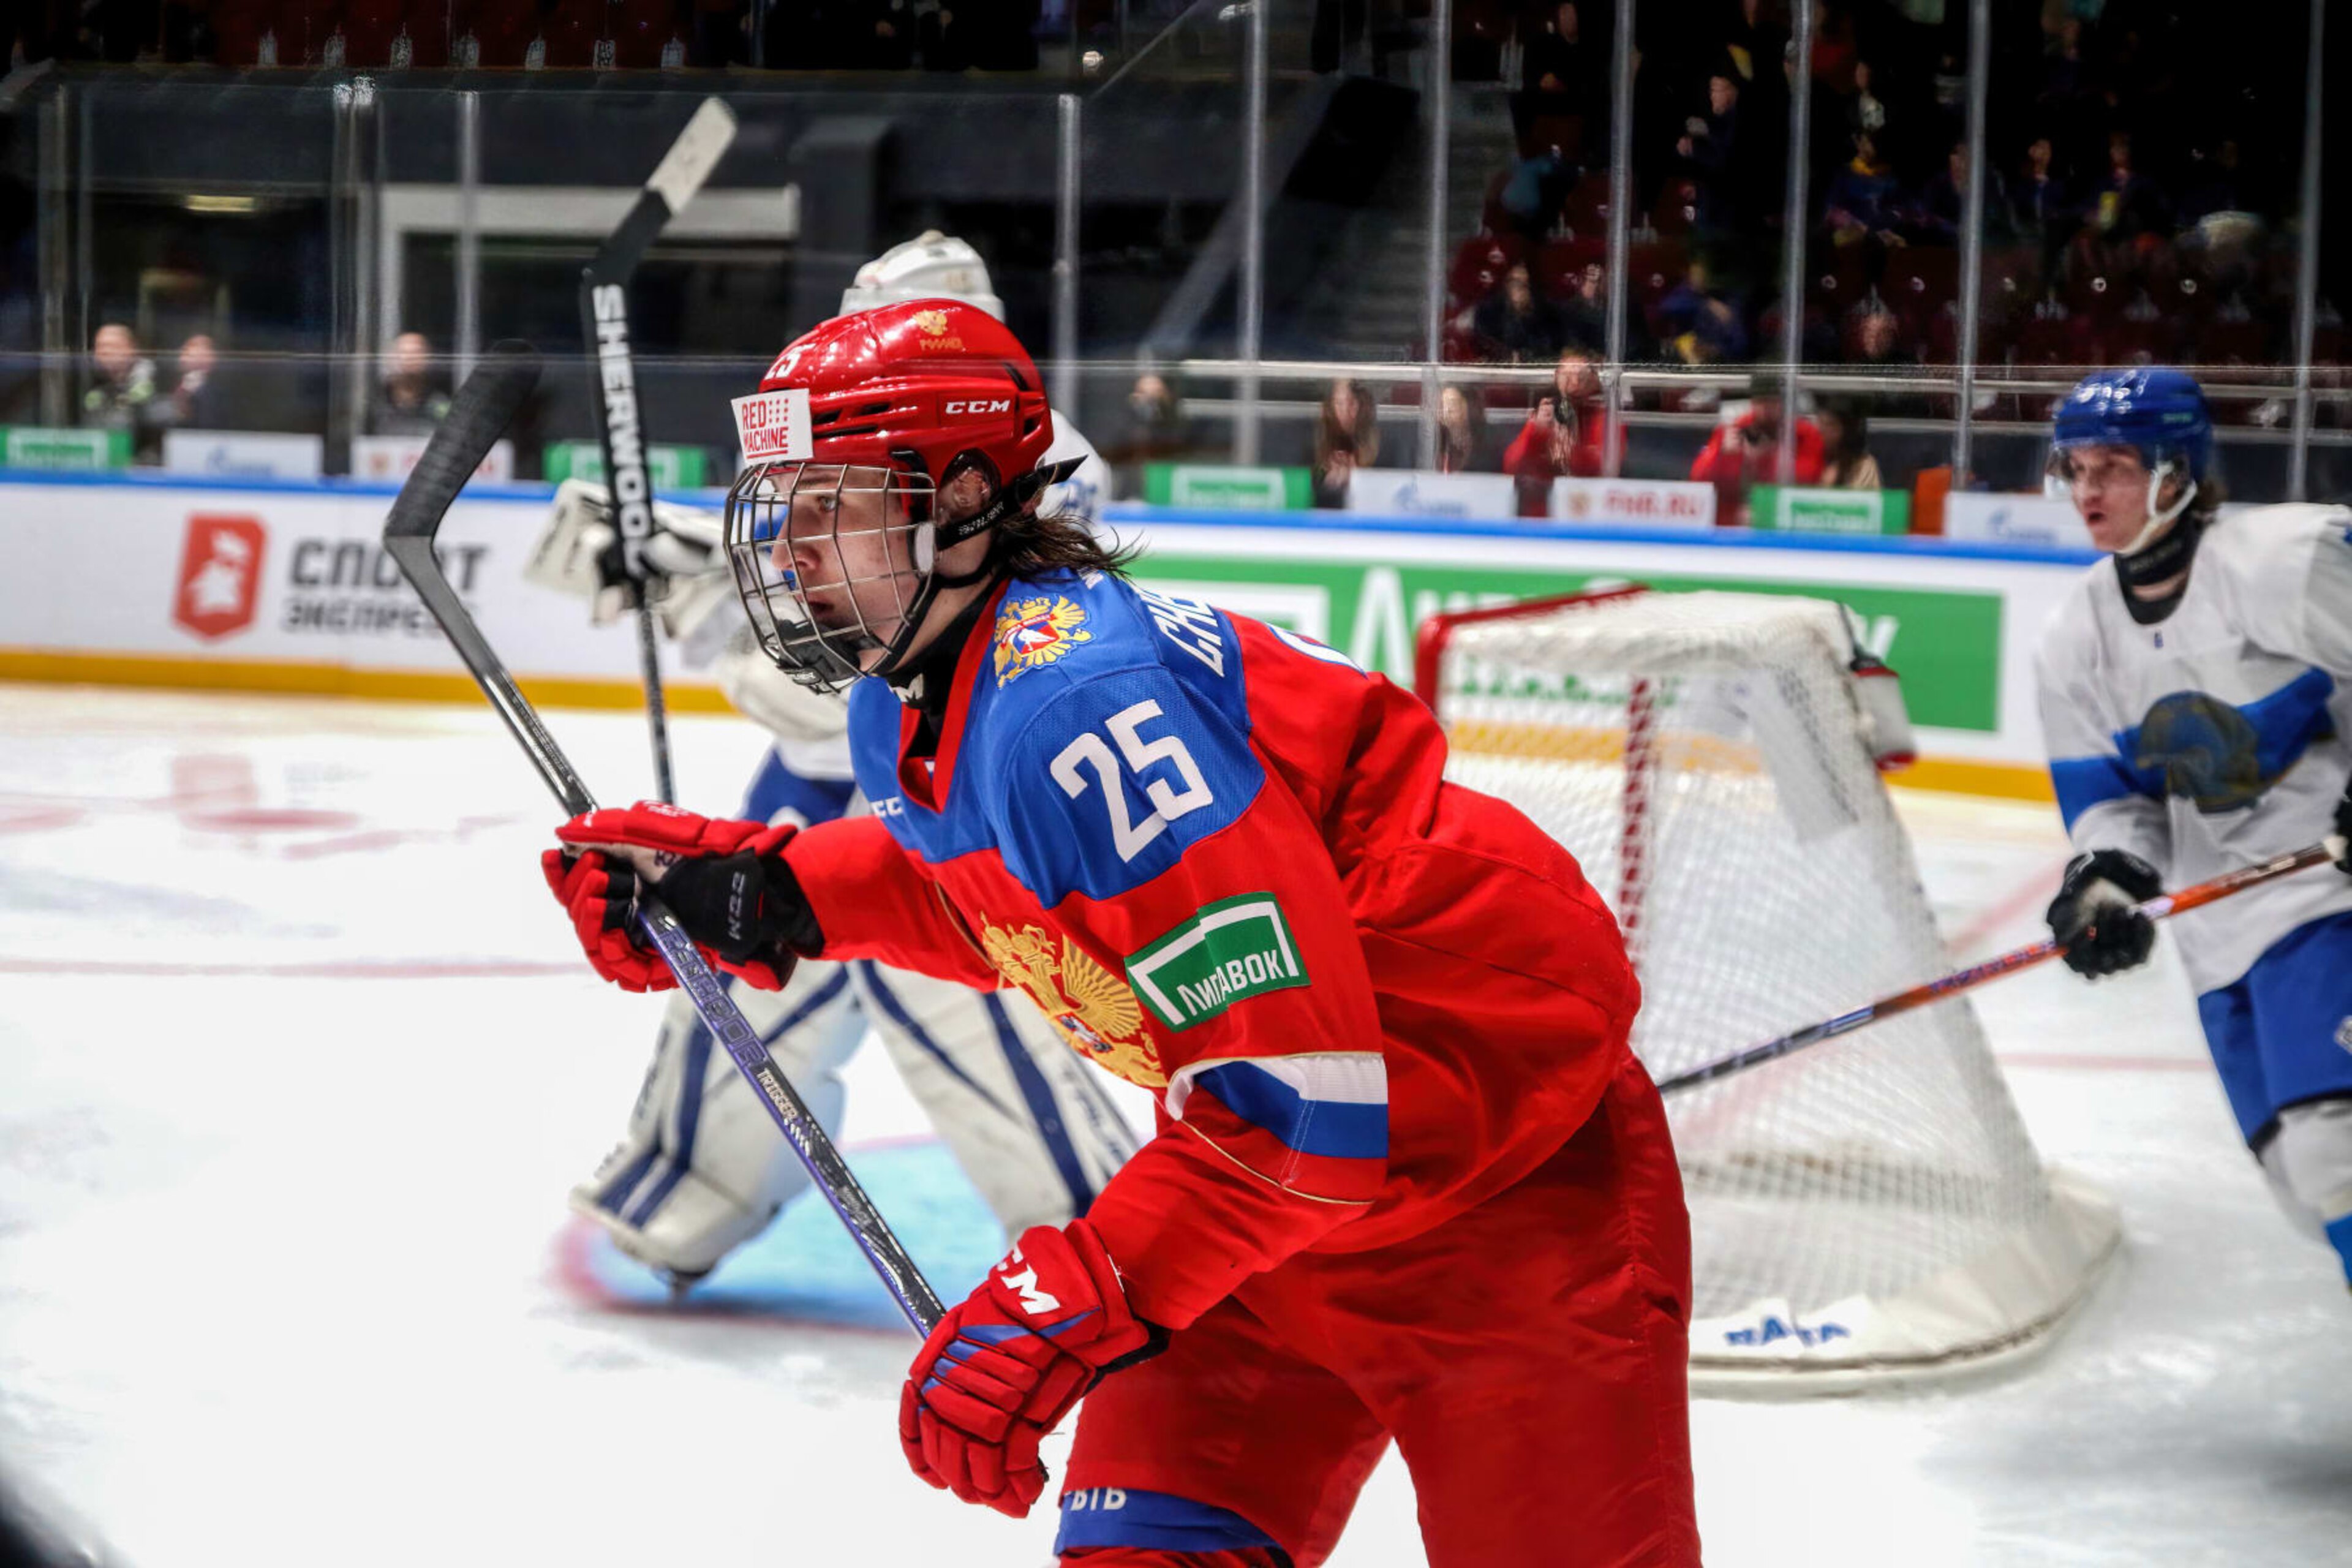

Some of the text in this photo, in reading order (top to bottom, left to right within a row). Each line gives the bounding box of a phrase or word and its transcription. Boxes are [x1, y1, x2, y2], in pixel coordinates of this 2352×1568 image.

[742, 400, 767, 430] RED
[945, 399, 1011, 415] CCM
[744, 426, 788, 452] MACHINE
[285, 538, 491, 590] СПОТ
[280, 597, 447, 637] ЭКСПРЕ
[1050, 699, 1213, 863] 25
[757, 1067, 798, 1121] TRIGGER
